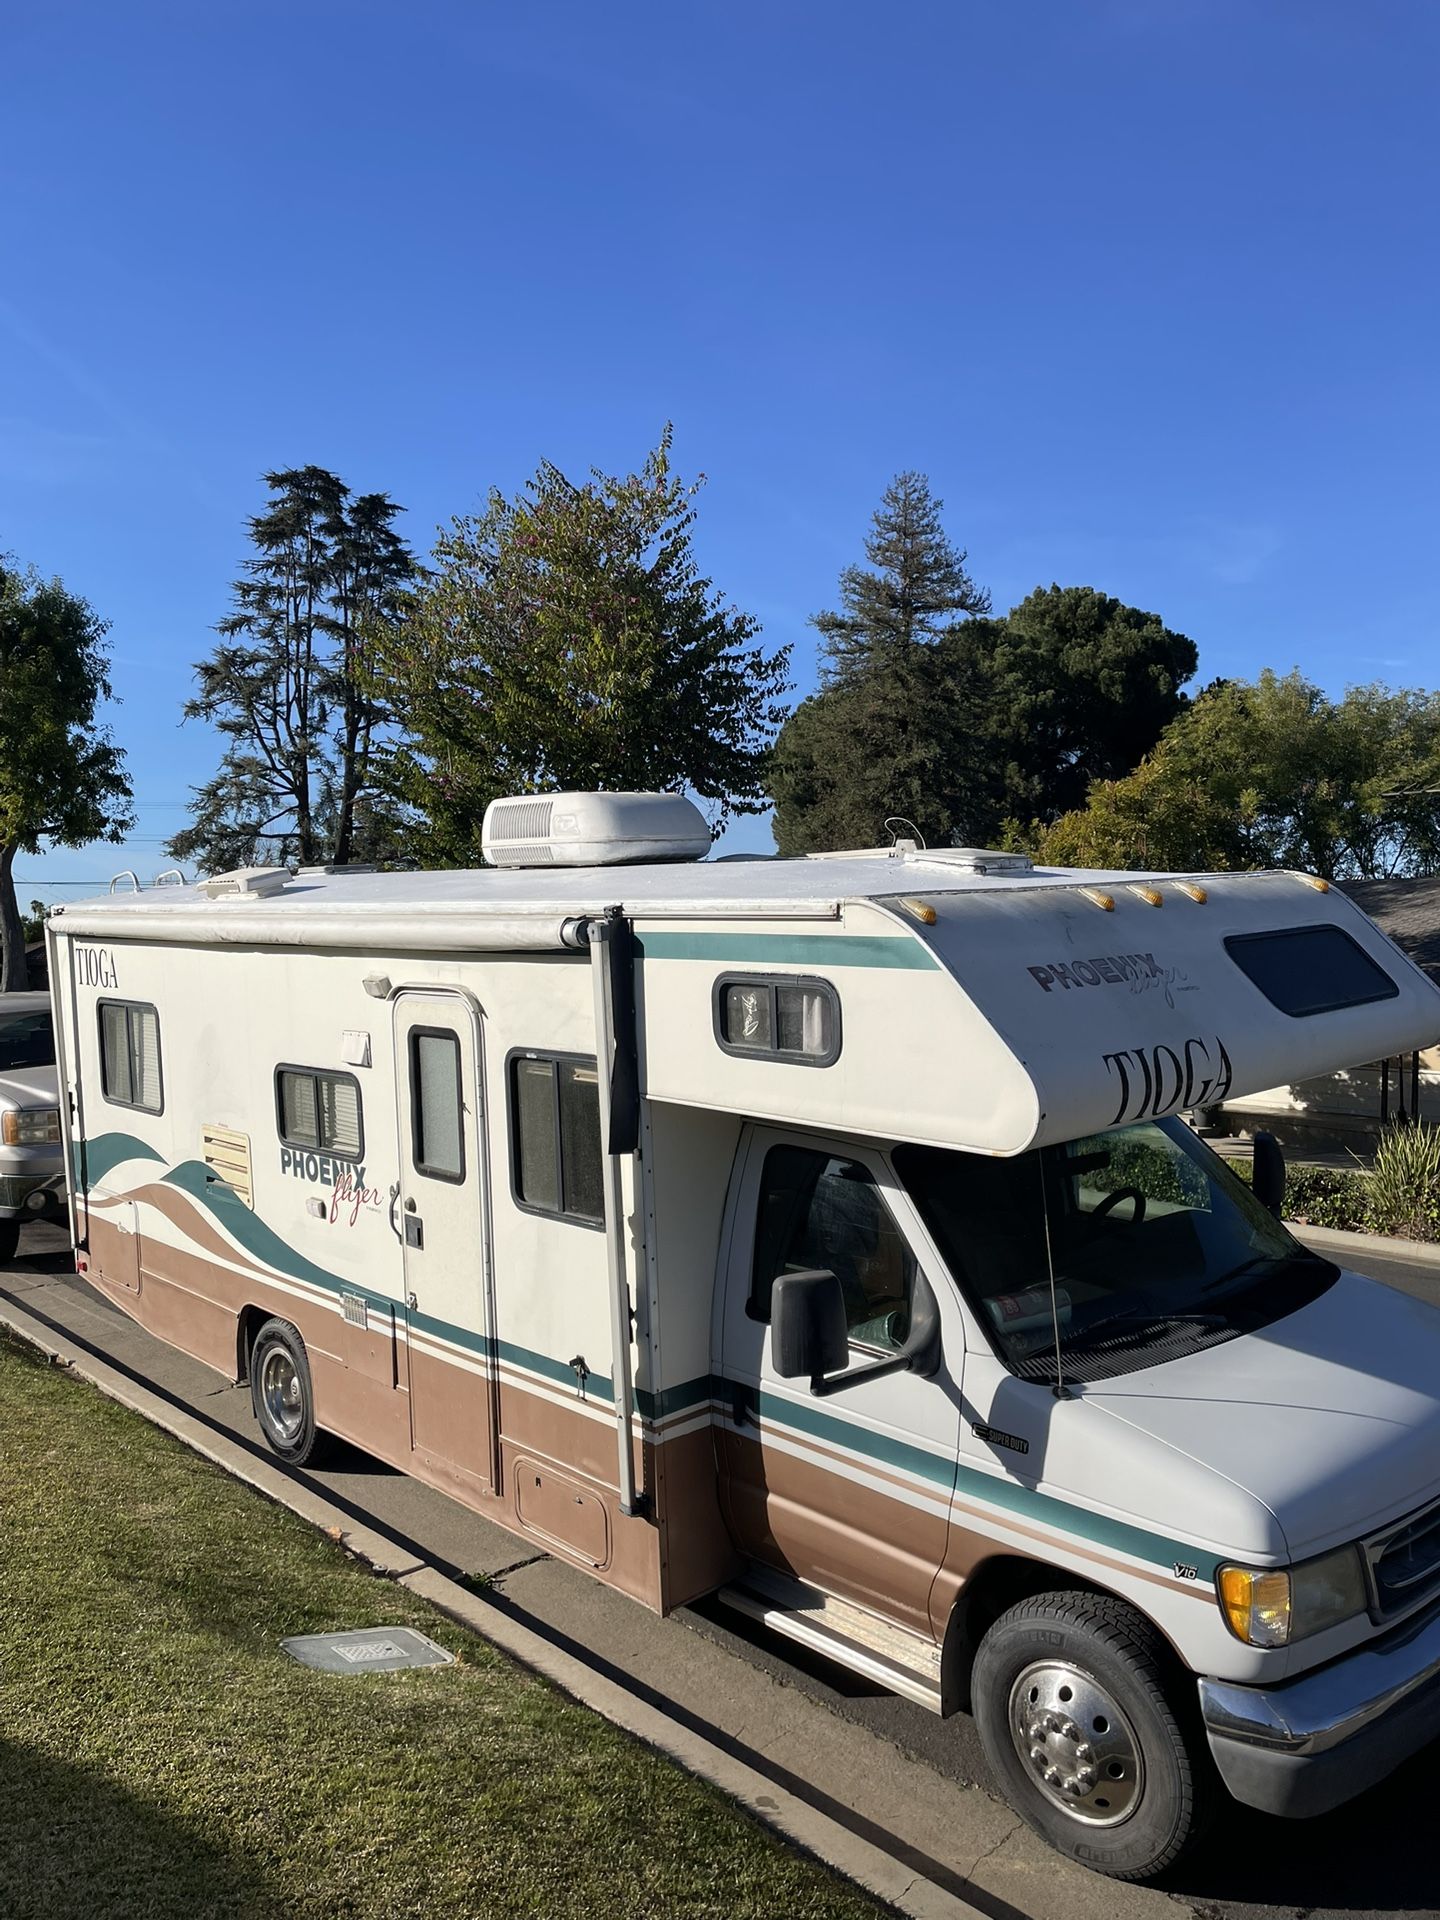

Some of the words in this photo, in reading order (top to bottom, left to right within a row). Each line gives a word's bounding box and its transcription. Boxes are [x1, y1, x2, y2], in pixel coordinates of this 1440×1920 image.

[75, 948, 119, 988] TIOGA
[1027, 953, 1163, 992] PHOENIX
[1102, 1036, 1232, 1126] TIOGA
[280, 1147, 366, 1193] PHOENIX
[330, 1172, 383, 1227] flyer
[988, 1430, 1009, 1447] SUPER
[1010, 1437, 1028, 1453] DUTY
